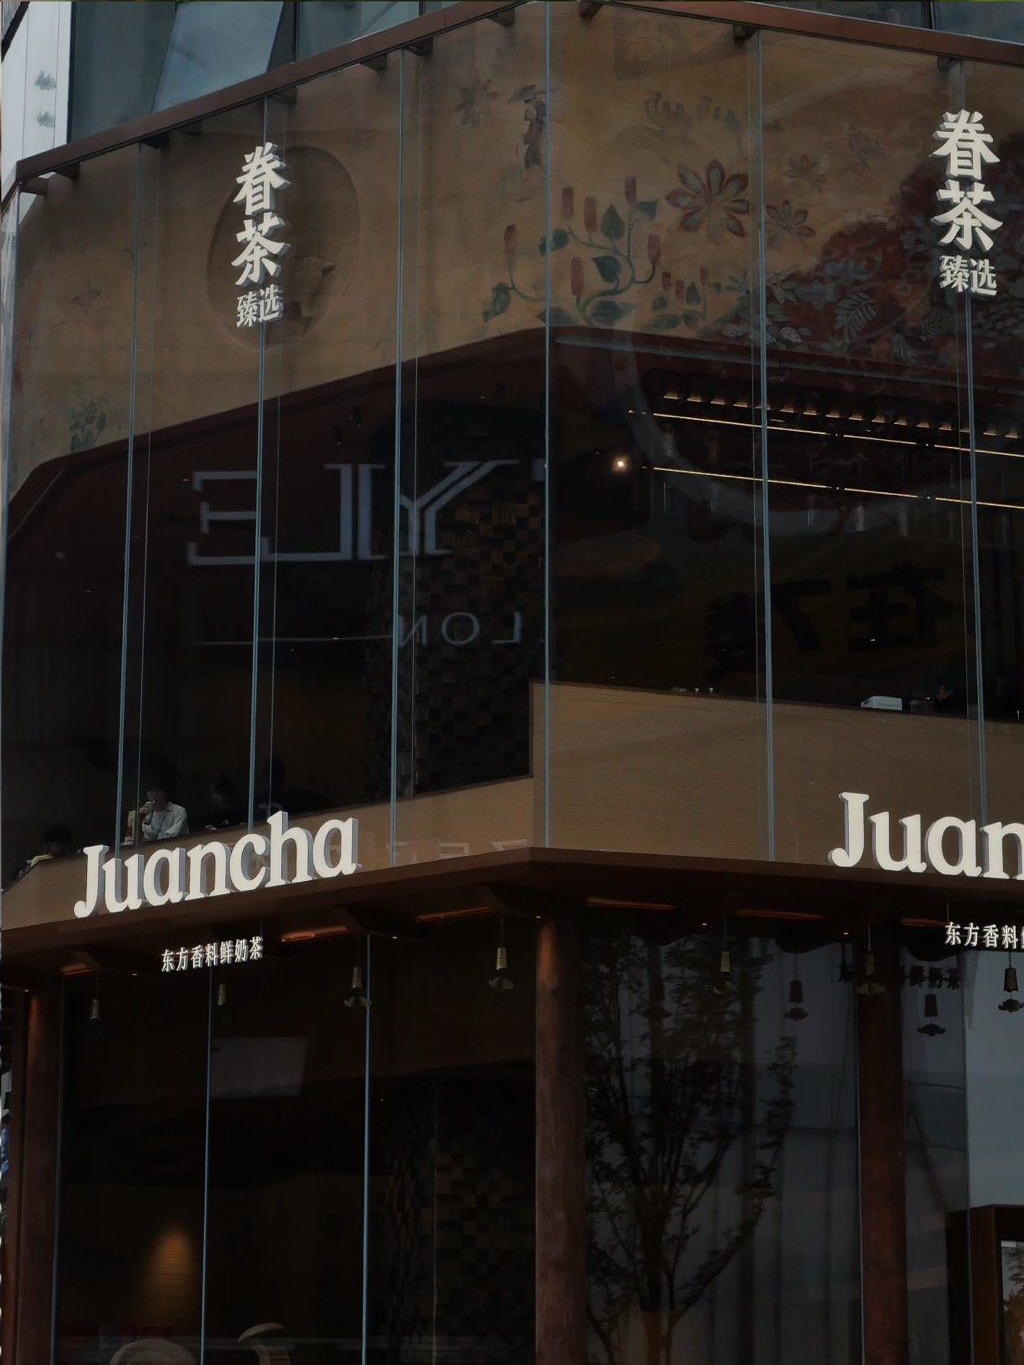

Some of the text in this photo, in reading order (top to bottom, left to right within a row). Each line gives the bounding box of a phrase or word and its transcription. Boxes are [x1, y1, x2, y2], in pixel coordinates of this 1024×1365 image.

[930, 108, 1003, 252] 眷茶
[230, 141, 292, 286] 眷茶
[939, 254, 998, 297] 臻选
[236, 283, 284, 328] 臻选
[73, 810, 359, 919] Juancha
[161, 936, 264, 973] 东方香料鲜奶茶
[944, 921, 1024, 950] 东方香料
